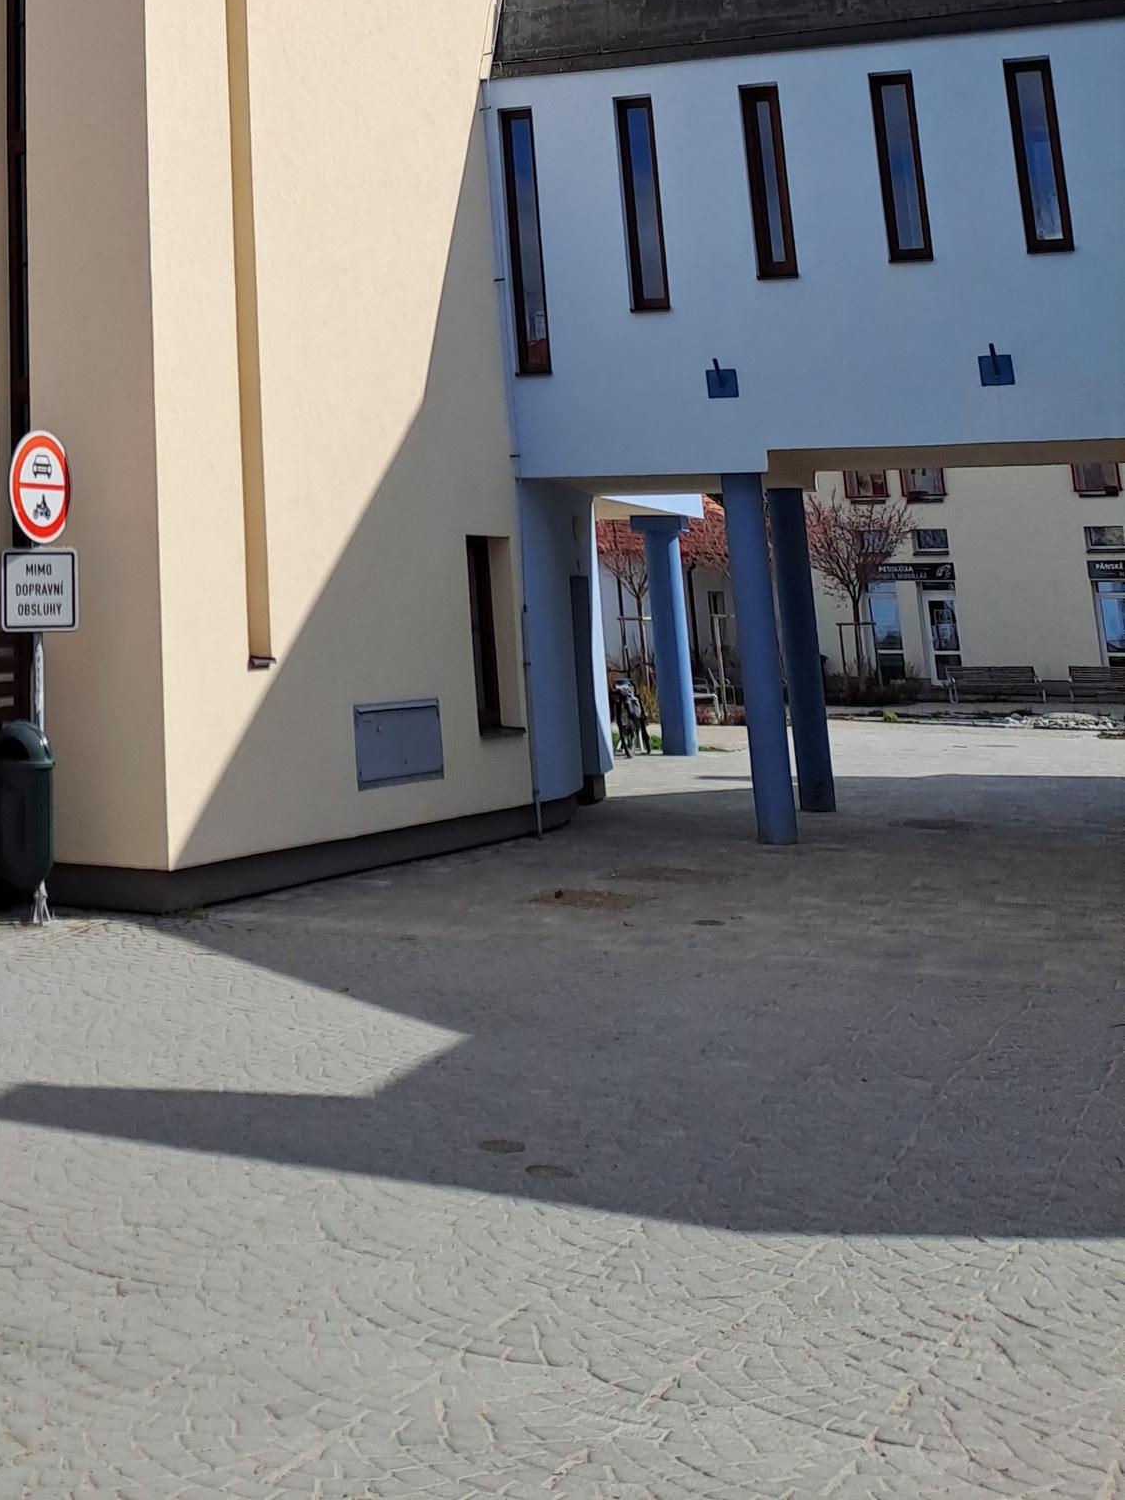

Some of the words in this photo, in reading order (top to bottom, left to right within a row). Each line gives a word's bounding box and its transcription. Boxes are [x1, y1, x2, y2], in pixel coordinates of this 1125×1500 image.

[25, 563, 53, 576] MIMO
[15, 581, 64, 597] DOPRAVNÍ
[17, 603, 63, 617] OBSLUHY
